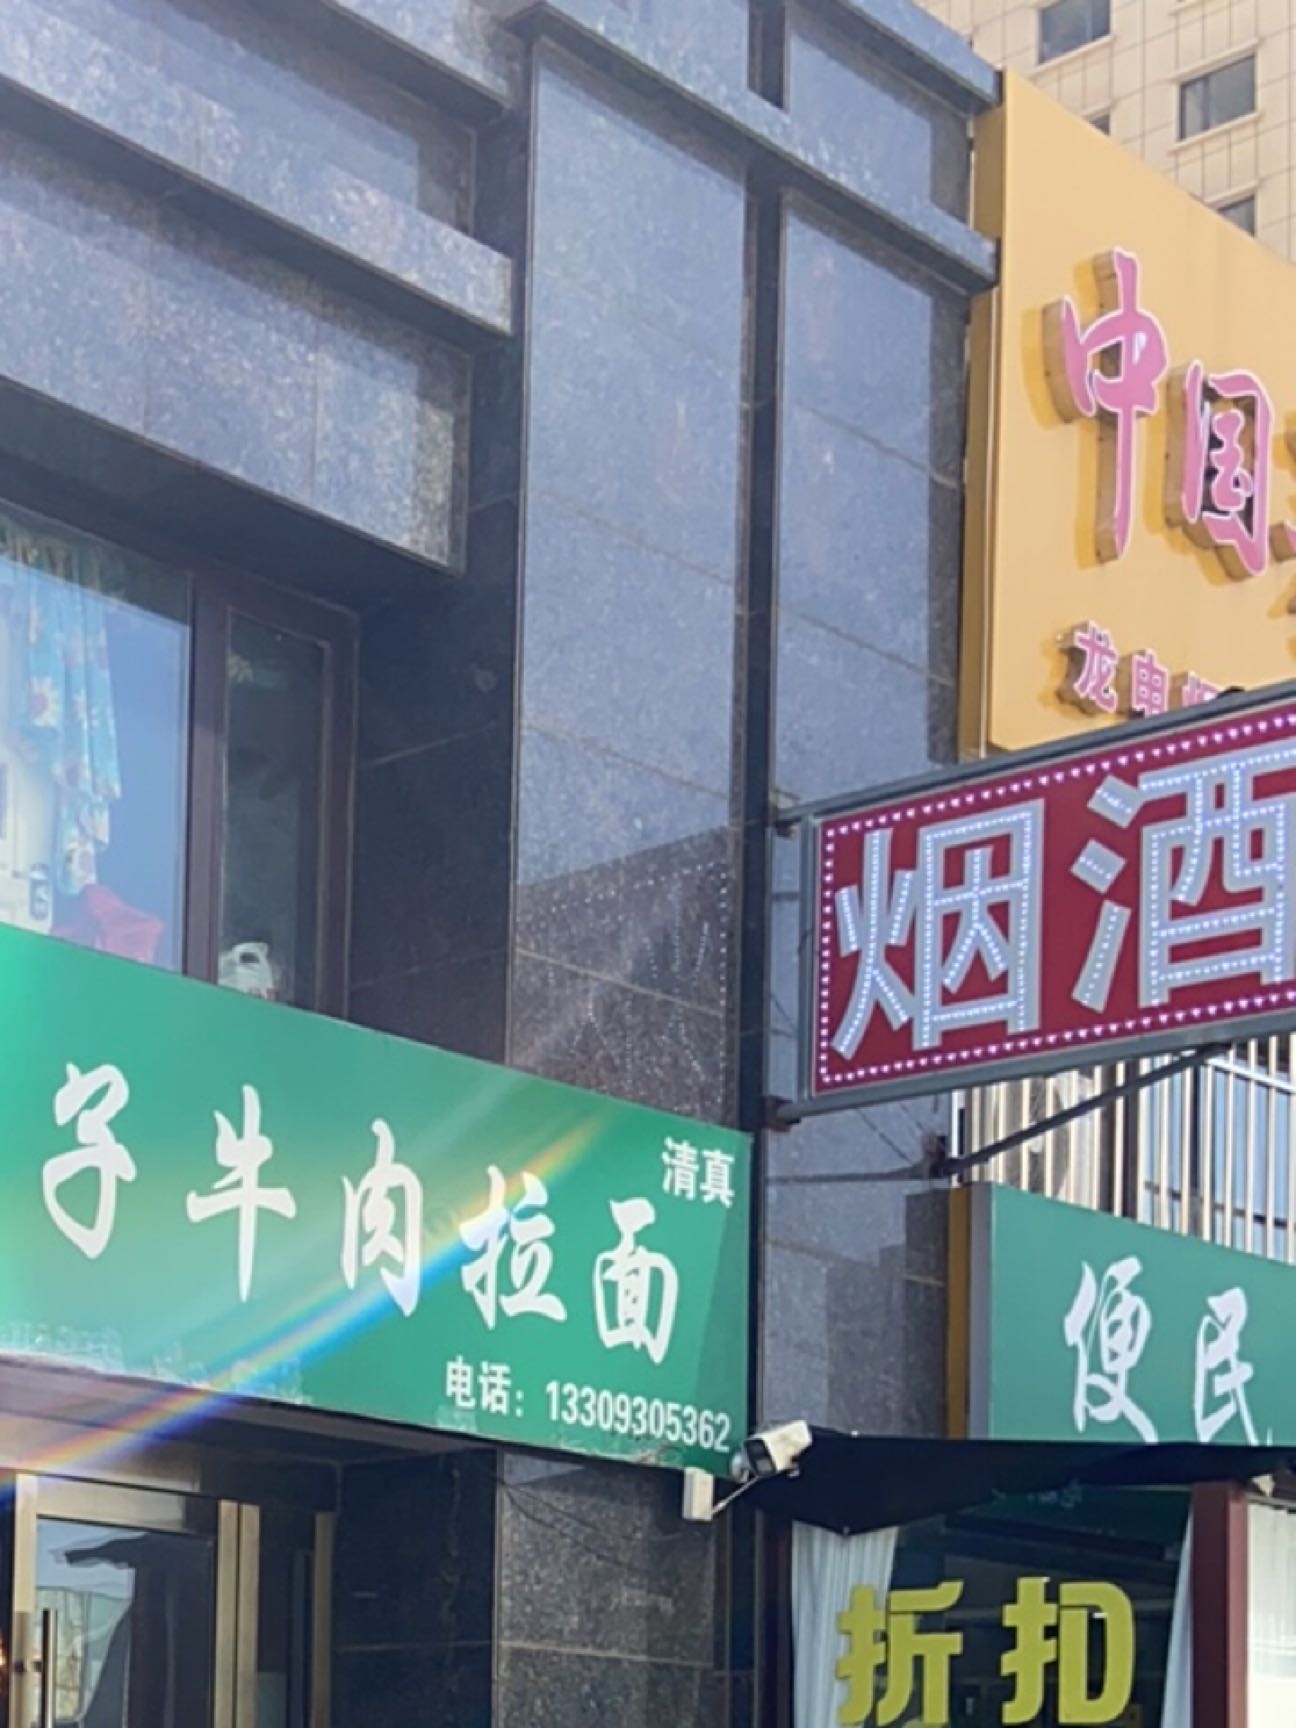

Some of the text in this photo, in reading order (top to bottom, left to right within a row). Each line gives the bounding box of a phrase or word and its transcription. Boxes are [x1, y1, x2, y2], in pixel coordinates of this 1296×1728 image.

[1061, 247, 1296, 576] 中国
[831, 736, 1296, 1061] 烟酒
[661, 1136, 736, 1209] 清真
[1064, 1255, 1274, 1447] 便民
[835, 1577, 1135, 1727] 折扣
